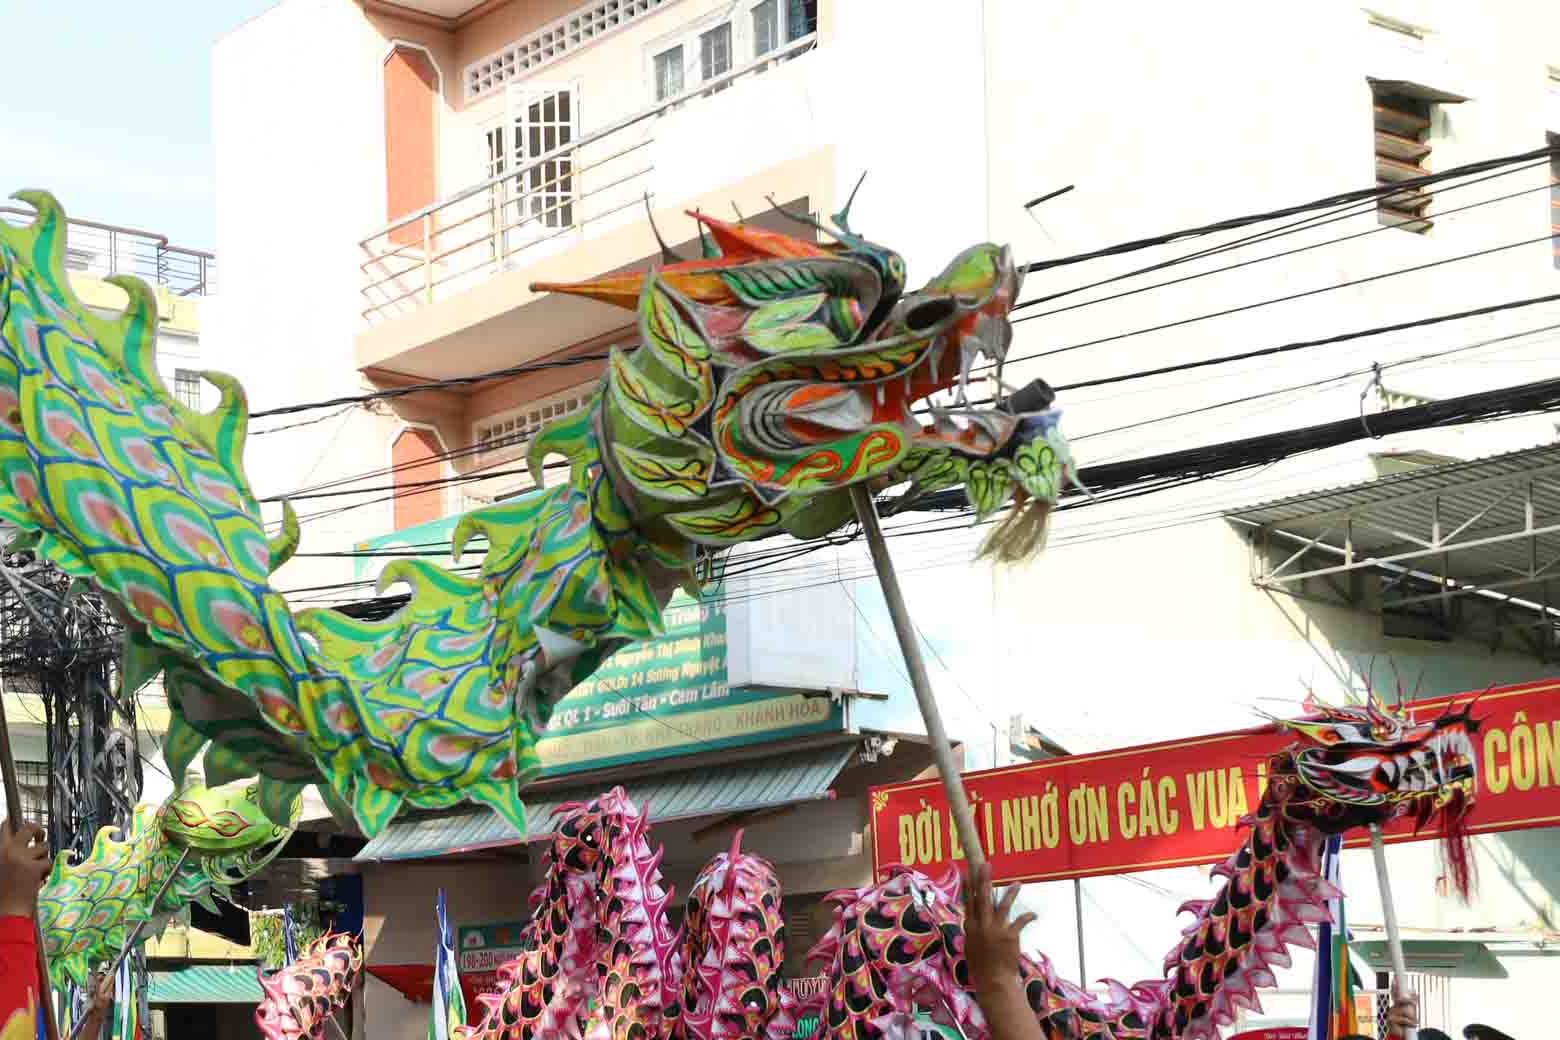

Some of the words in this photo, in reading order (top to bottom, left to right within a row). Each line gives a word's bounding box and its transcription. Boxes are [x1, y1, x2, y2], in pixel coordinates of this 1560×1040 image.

[1002, 780, 1060, 855] NHỚ
[1068, 781, 1110, 846] ƠN
[1117, 767, 1179, 840] CÁC
[1186, 766, 1250, 831] VUA
